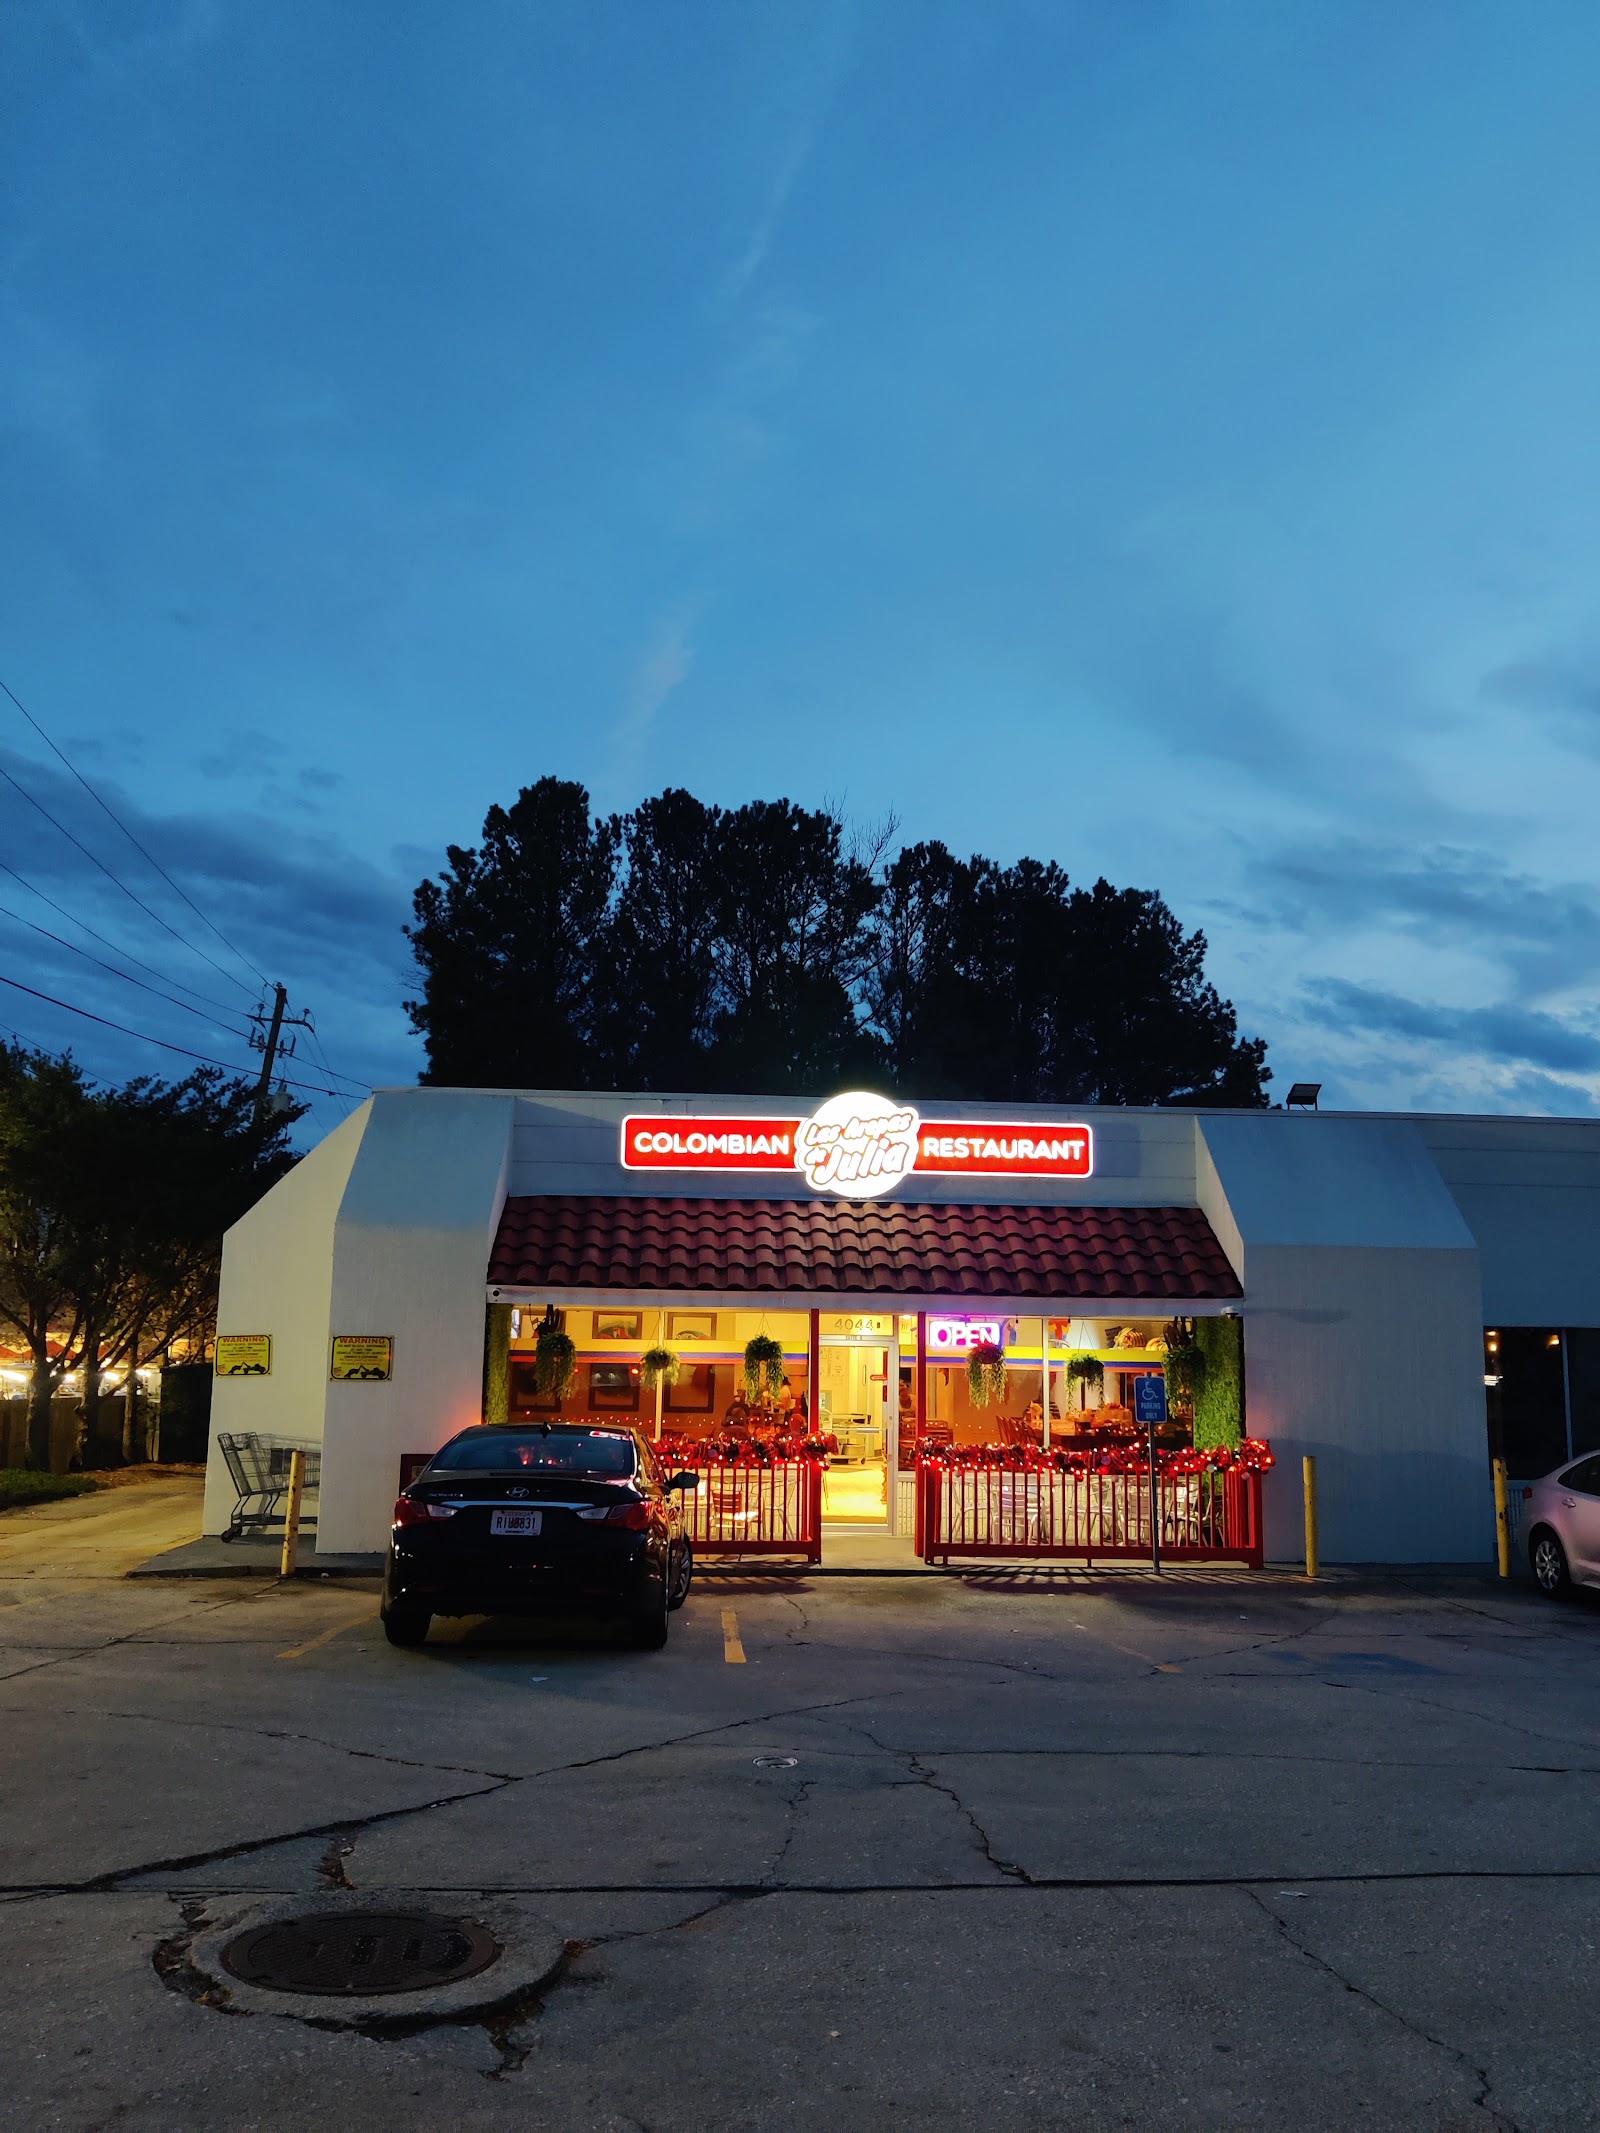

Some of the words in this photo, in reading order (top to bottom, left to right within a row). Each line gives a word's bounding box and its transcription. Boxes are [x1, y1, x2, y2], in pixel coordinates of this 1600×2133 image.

[804, 1123, 842, 1146] Las
[843, 1113, 914, 1140] Arepas
[634, 1131, 789, 1155] COLOMBIAN
[922, 1137, 1085, 1160] RESTAURANT
[811, 1138, 910, 1185] Julia
[834, 1318, 873, 1330] 4044
[935, 1325, 996, 1347] OPEN
[1140, 1402, 1161, 1410] PARKING
[1145, 1411, 1158, 1419] ONLY
